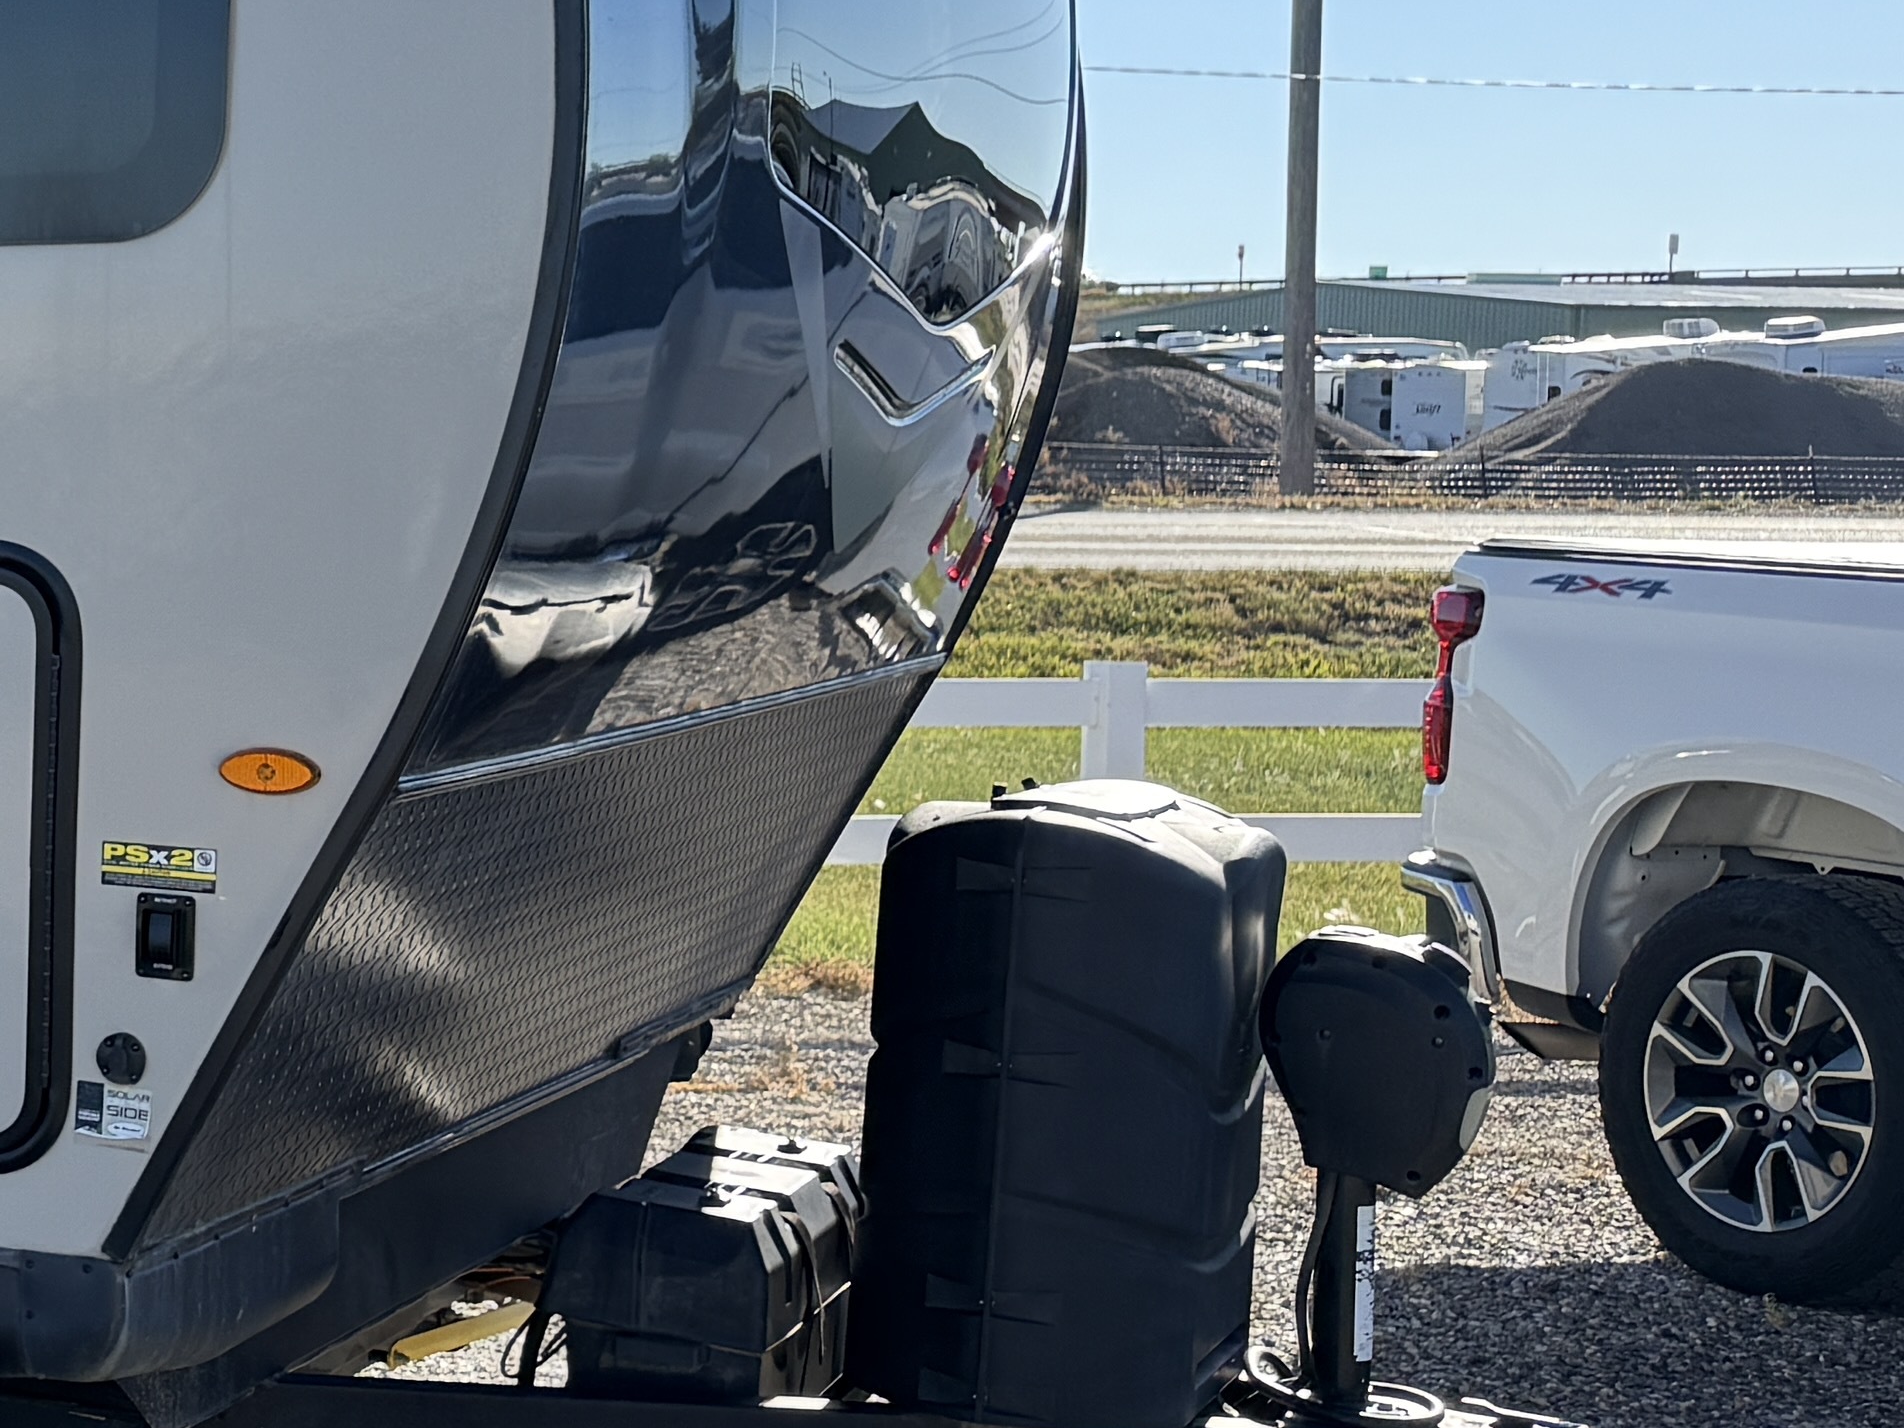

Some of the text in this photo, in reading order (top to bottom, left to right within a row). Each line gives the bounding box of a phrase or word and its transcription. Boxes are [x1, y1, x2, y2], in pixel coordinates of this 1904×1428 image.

[103, 842, 193, 867] PSx2
[107, 1089, 151, 1103] SOLAR
[106, 1105, 149, 1121] SIDE
